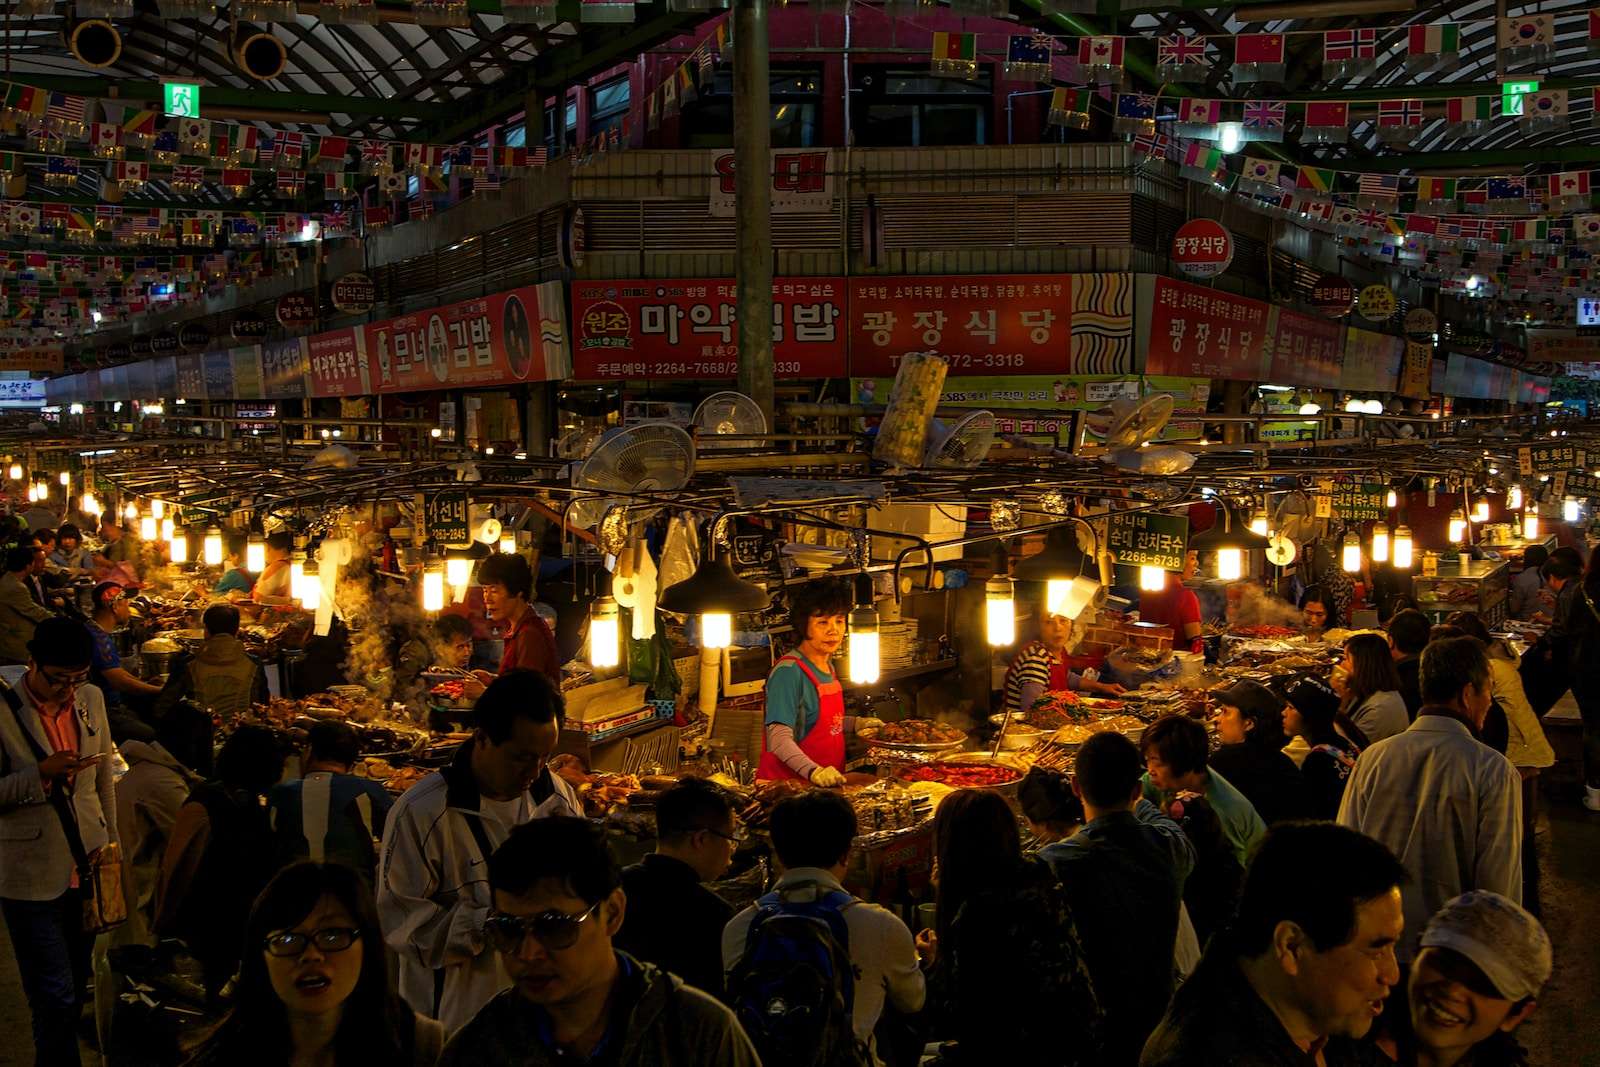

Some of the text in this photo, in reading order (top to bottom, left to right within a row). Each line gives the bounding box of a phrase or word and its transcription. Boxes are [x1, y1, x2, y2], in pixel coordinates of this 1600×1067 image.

[1176, 237, 1226, 255] 광장식당
[337, 286, 376, 301] 마약김밥
[862, 309, 1056, 347] 광장식당
[449, 316, 493, 368] 김밥
[1169, 319, 1252, 360] 광장식당
[655, 361, 800, 375] 2264-7668/2330
[942, 354, 1024, 368] 72-3318
[1111, 528, 1184, 553] 순대 잔치국수
[1120, 550, 1181, 567] 2268-6738
